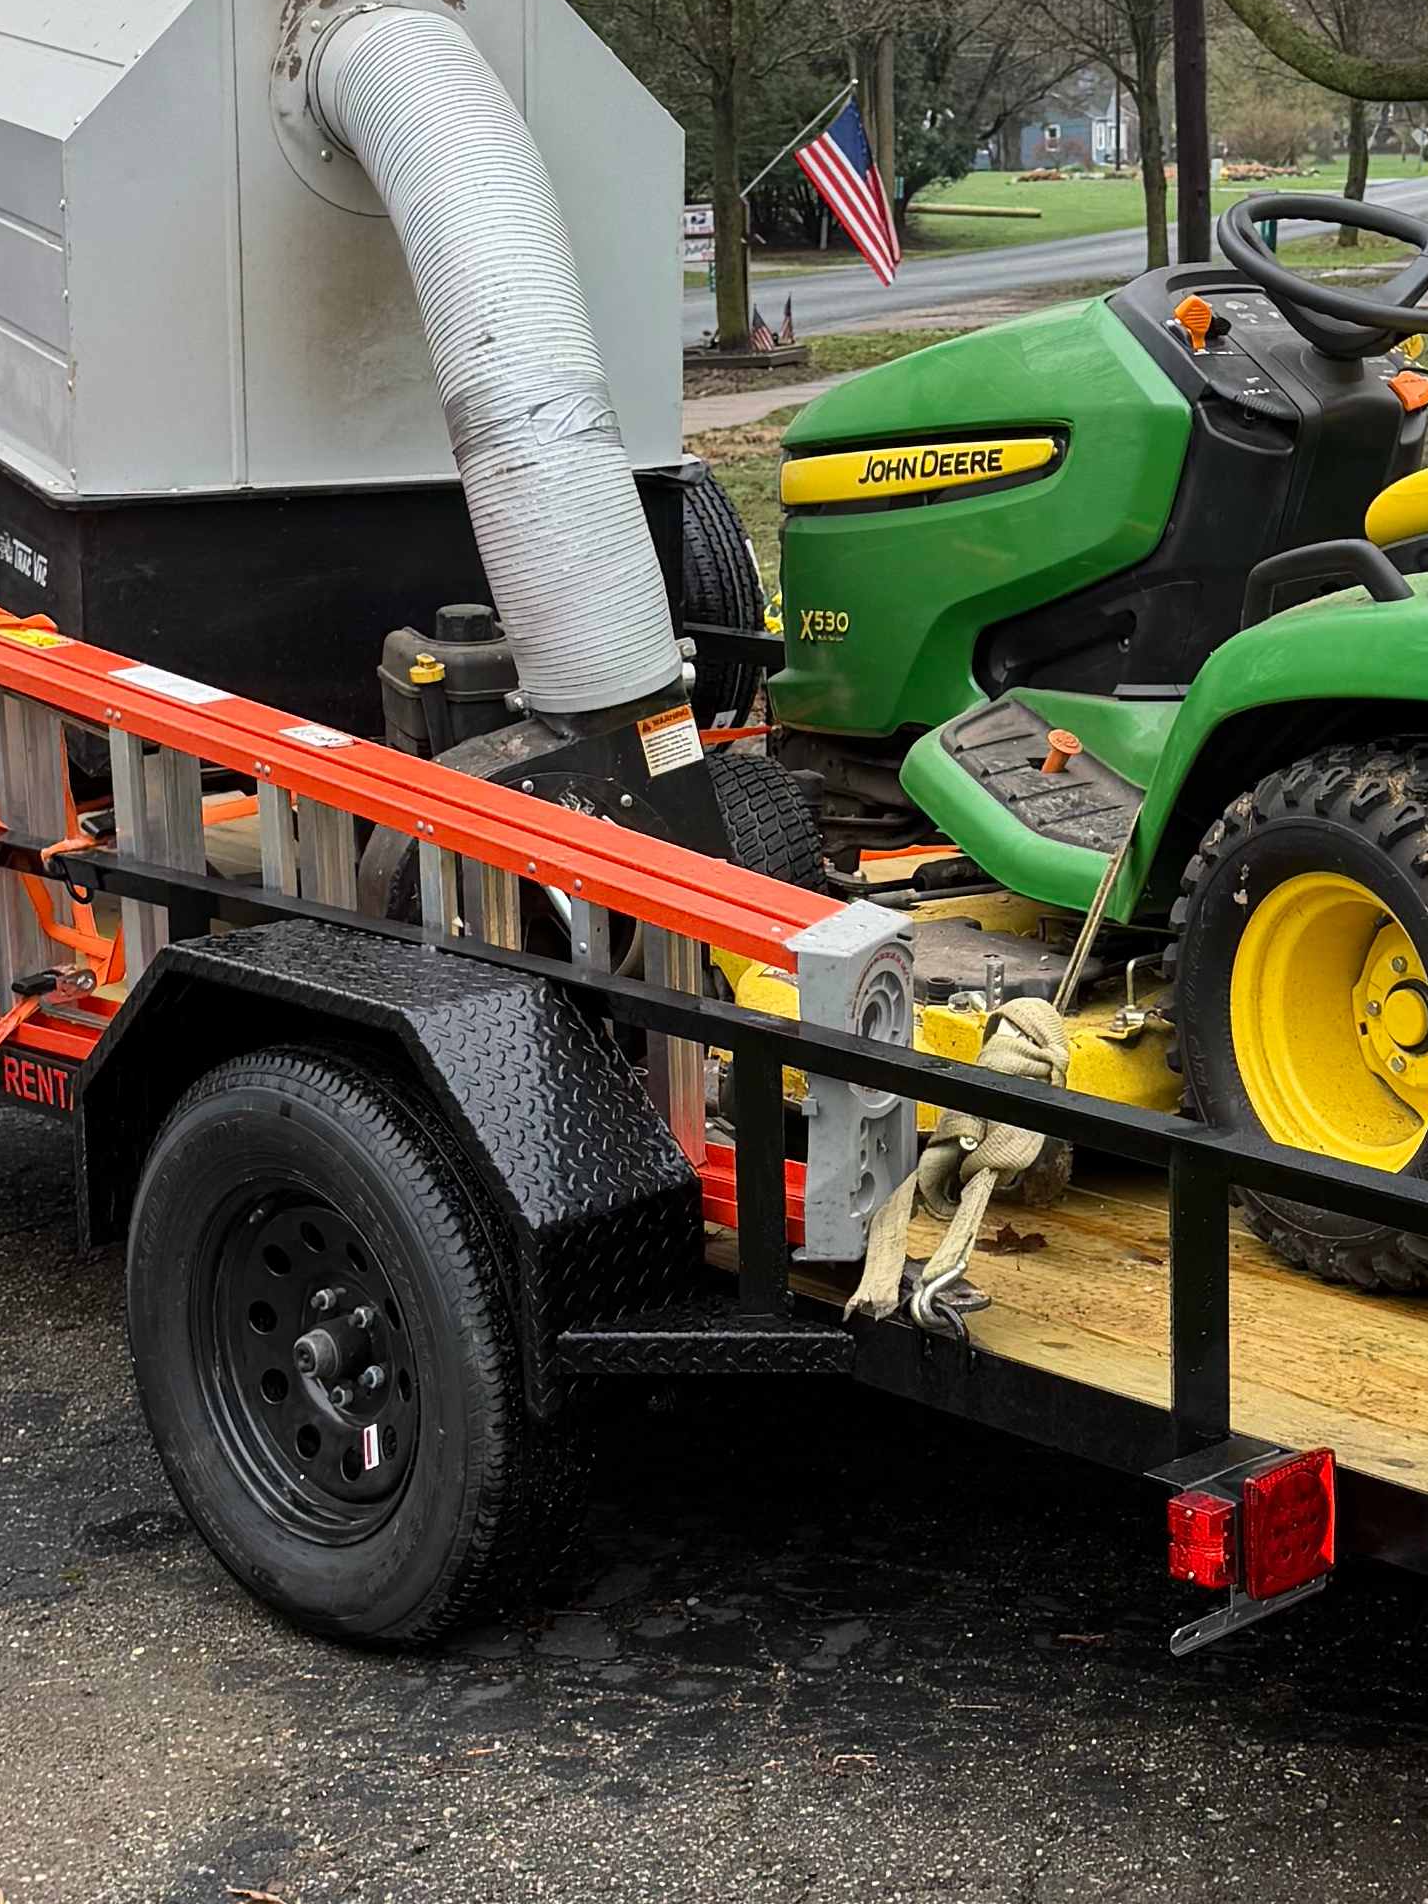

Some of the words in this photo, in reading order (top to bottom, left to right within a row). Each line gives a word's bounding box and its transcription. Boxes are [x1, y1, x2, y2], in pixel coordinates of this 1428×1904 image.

[858, 455, 918, 485] JOHN
[921, 448, 1004, 478] DEERE
[800, 610, 849, 641] X530
[3, 1055, 76, 1112] RENT
